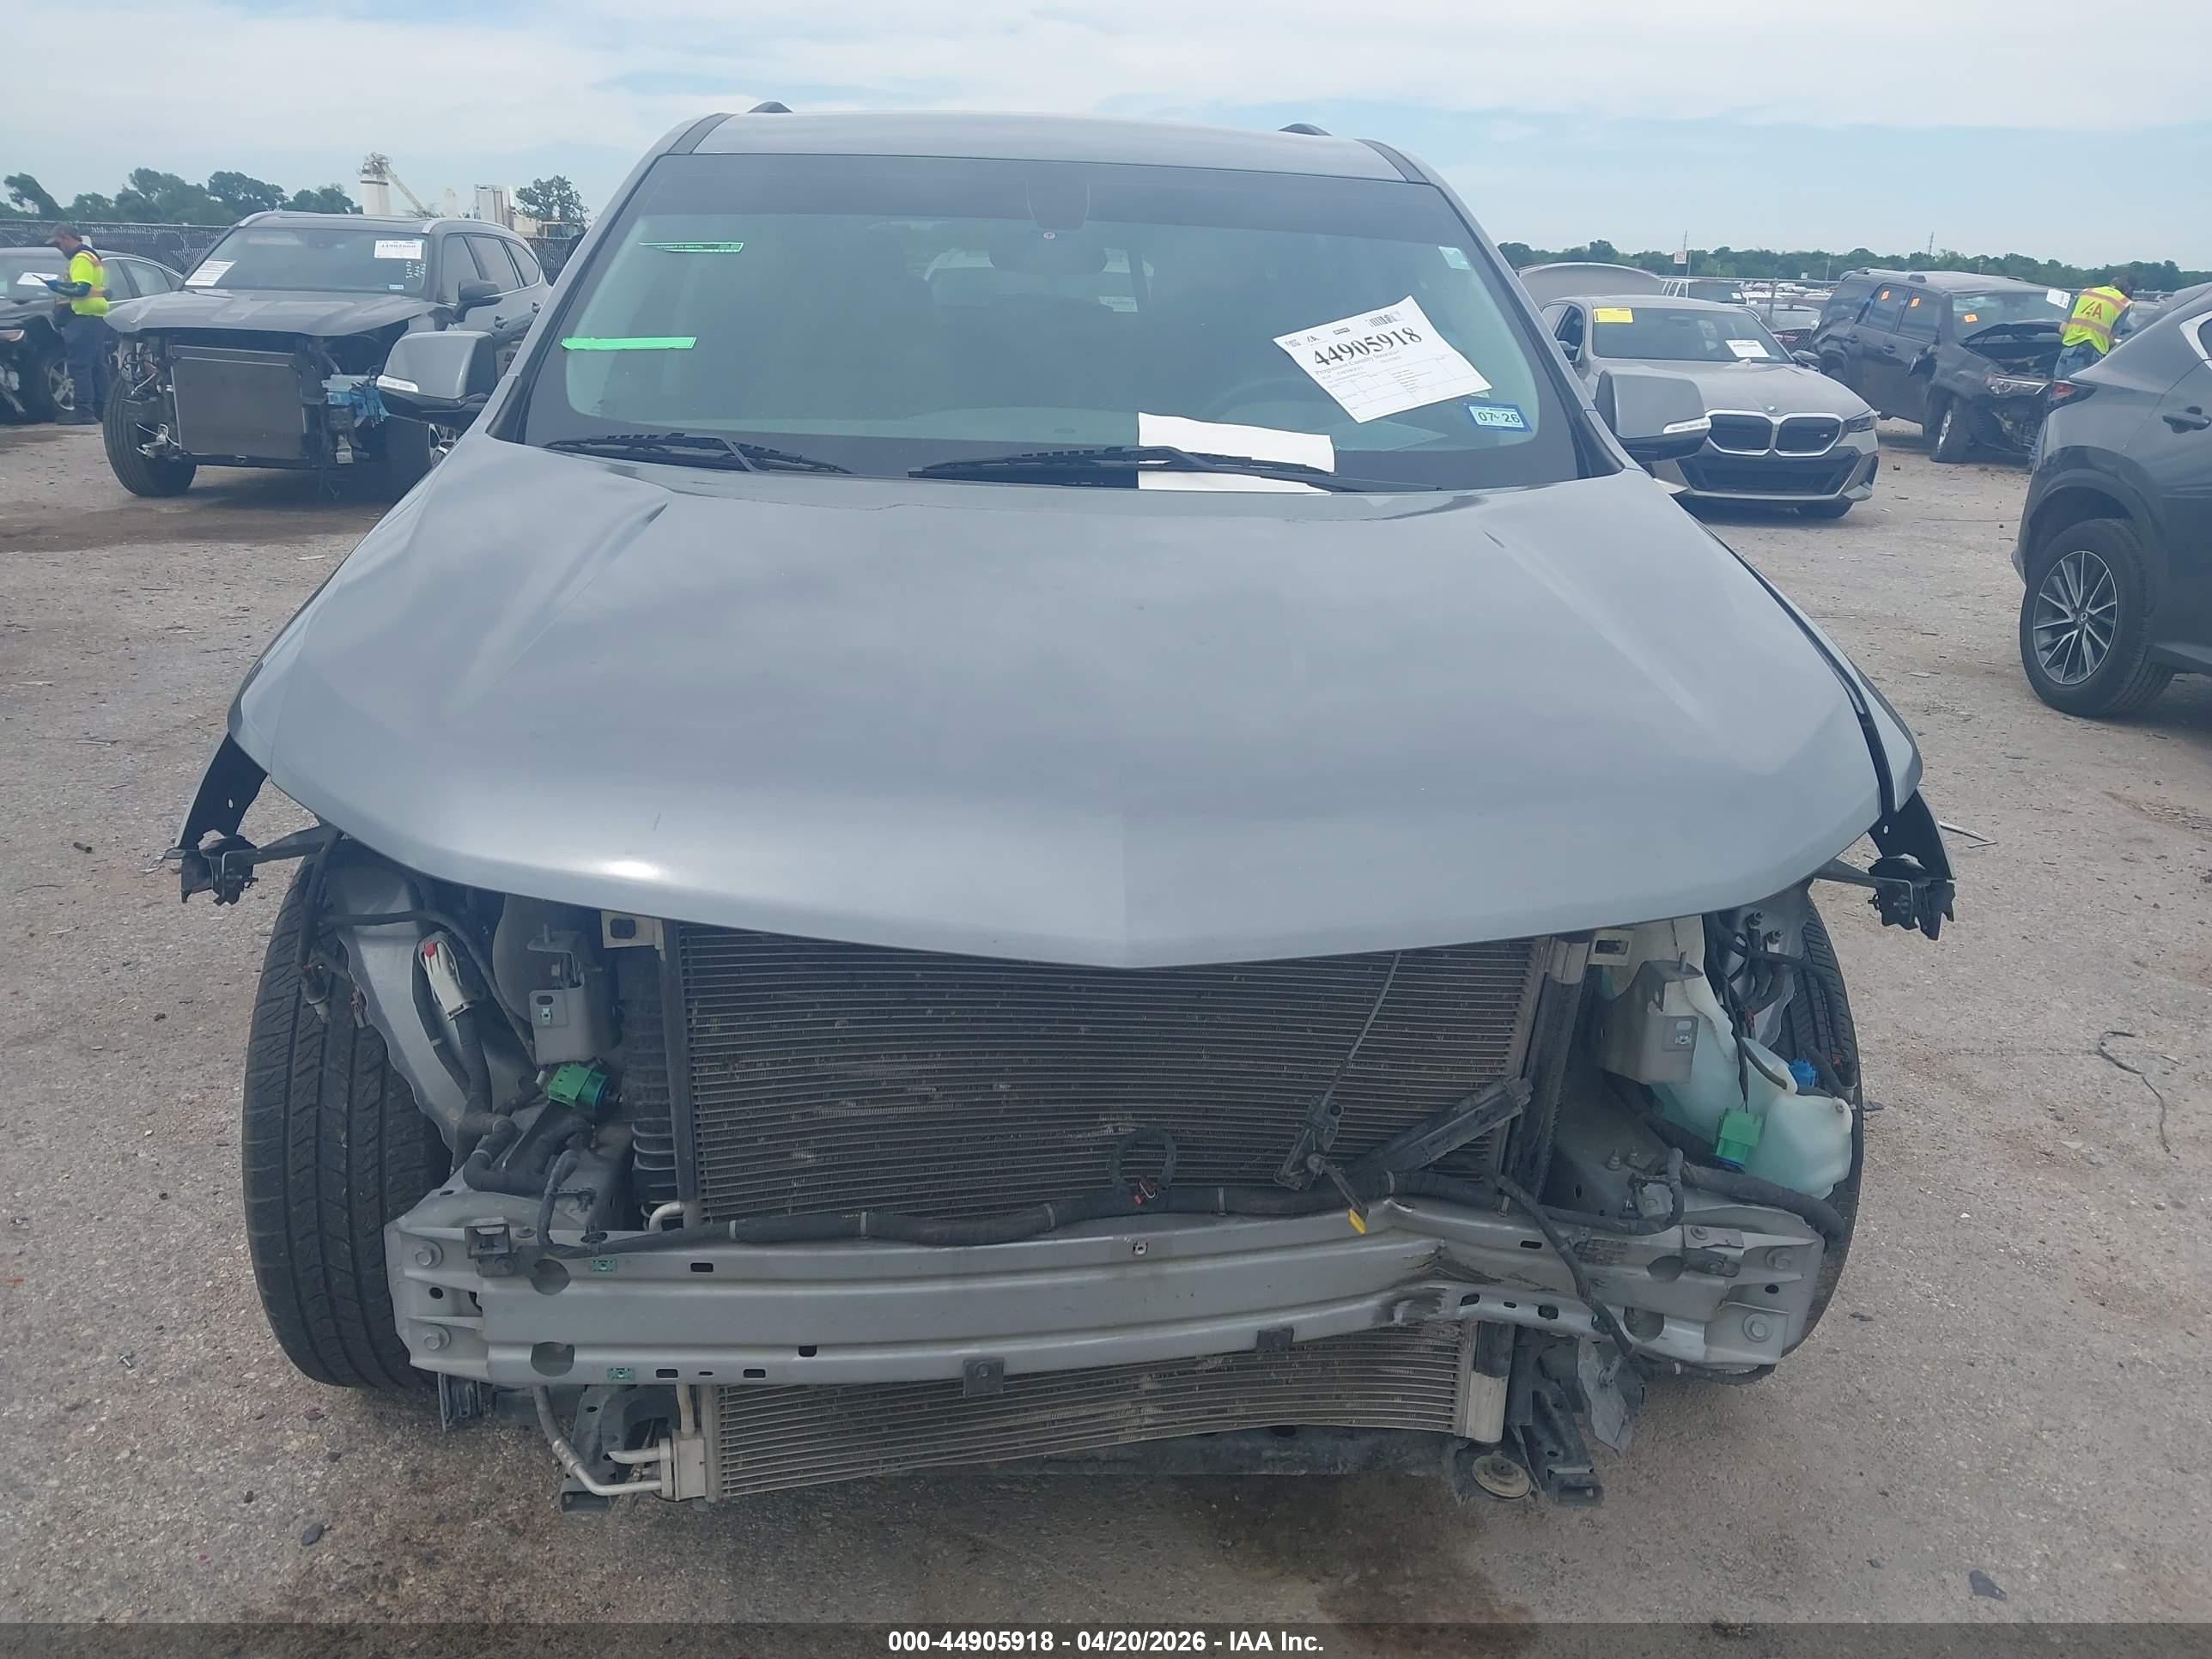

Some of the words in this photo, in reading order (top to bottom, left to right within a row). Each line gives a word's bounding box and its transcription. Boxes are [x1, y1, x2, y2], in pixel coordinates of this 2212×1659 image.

[1315, 327, 1423, 366] 44905918
[1478, 411, 1494, 422] 07
[1501, 412, 1521, 423] 26
